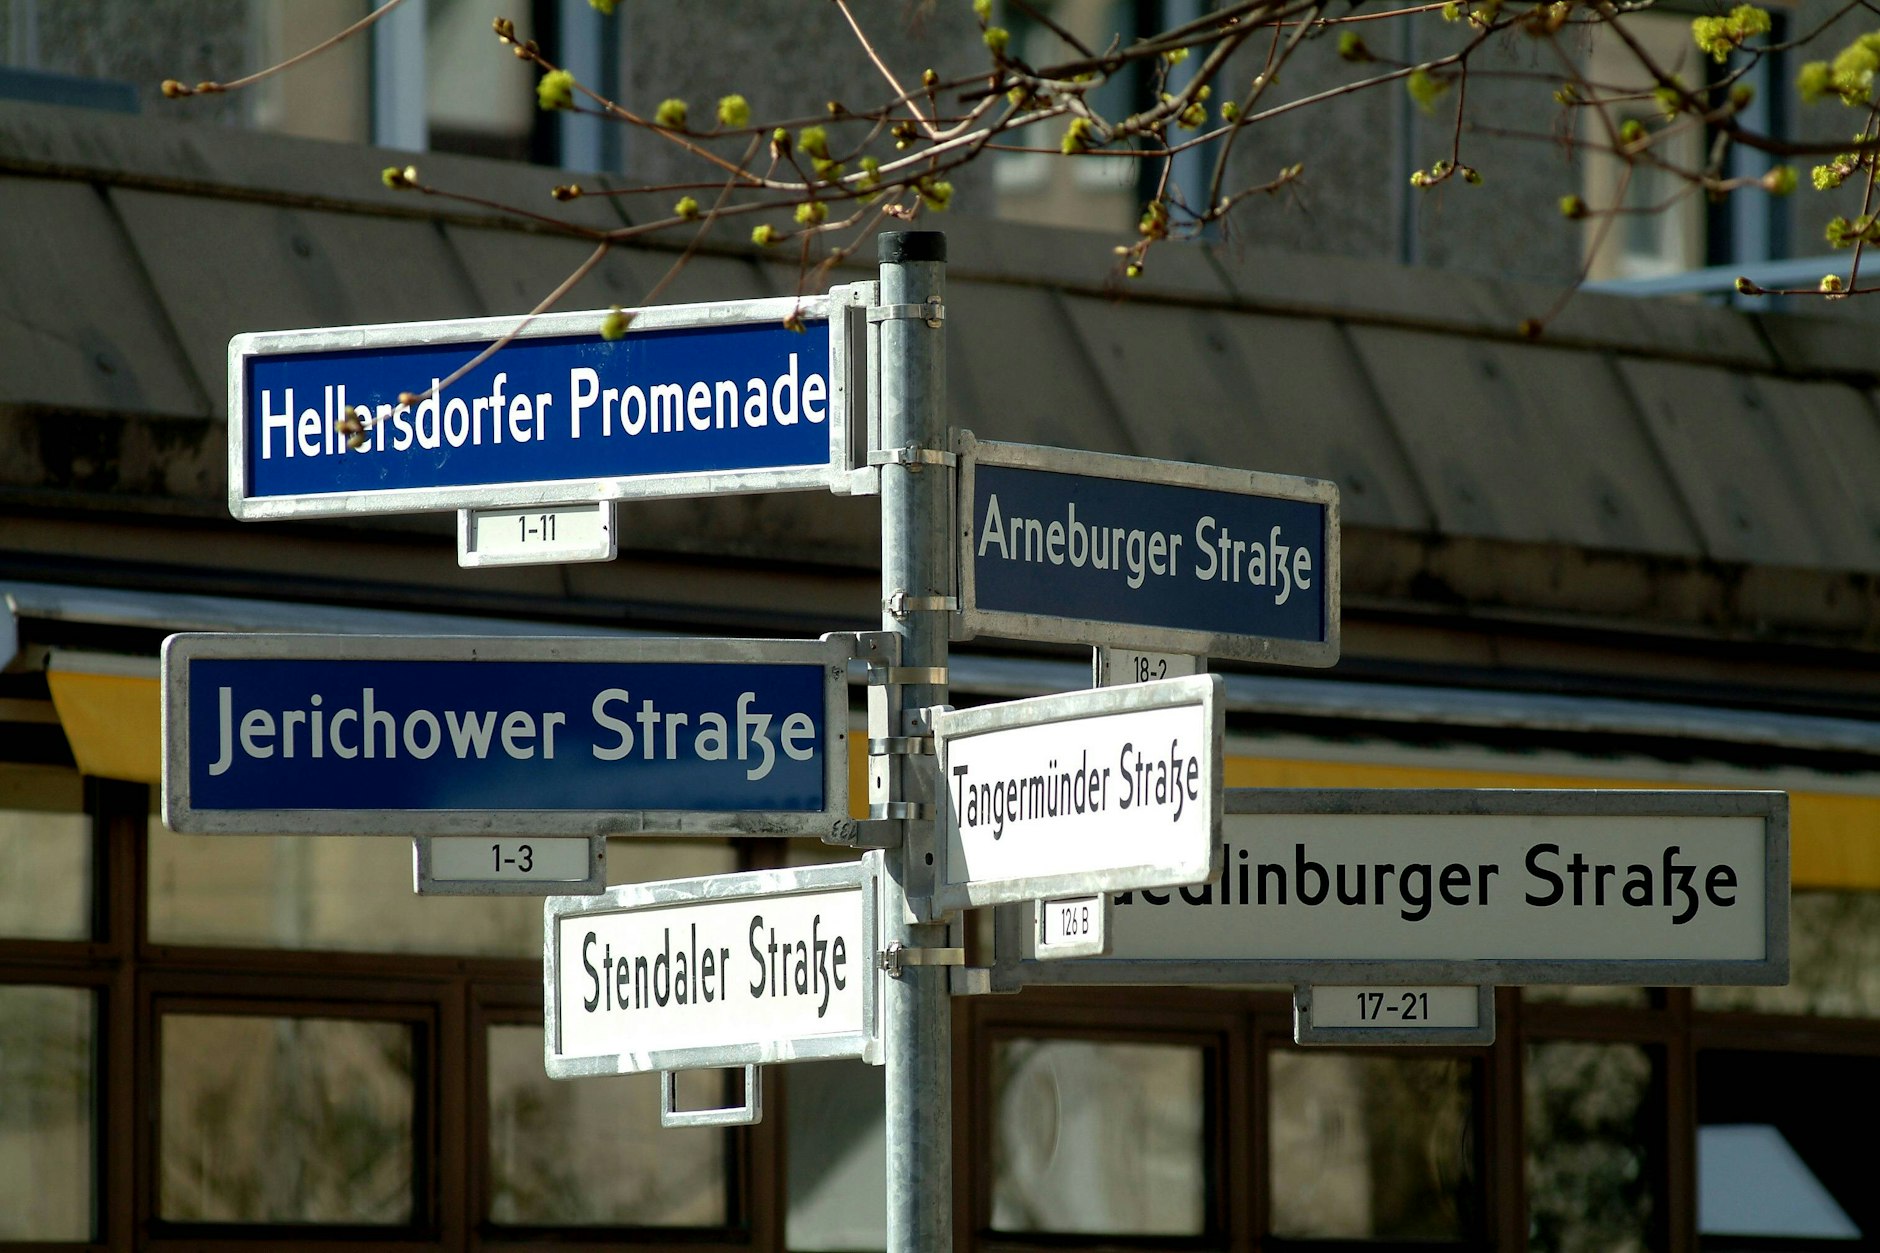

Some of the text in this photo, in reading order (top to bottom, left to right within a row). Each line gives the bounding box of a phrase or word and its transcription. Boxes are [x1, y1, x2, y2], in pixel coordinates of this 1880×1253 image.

[261, 352, 827, 460] Hellersdorfer Promenade
[518, 514, 557, 542] 1-11
[978, 493, 1312, 605] Arneburger Straße
[209, 687, 815, 781] Jerichower Straße
[953, 738, 1199, 840] Tangermünder Straße
[492, 845, 534, 873] 1-3
[1525, 843, 1738, 925] Straße
[1061, 906, 1089, 936] 126 B
[583, 914, 847, 1018] Stendaler Straße
[1357, 992, 1430, 1021] 17-21
